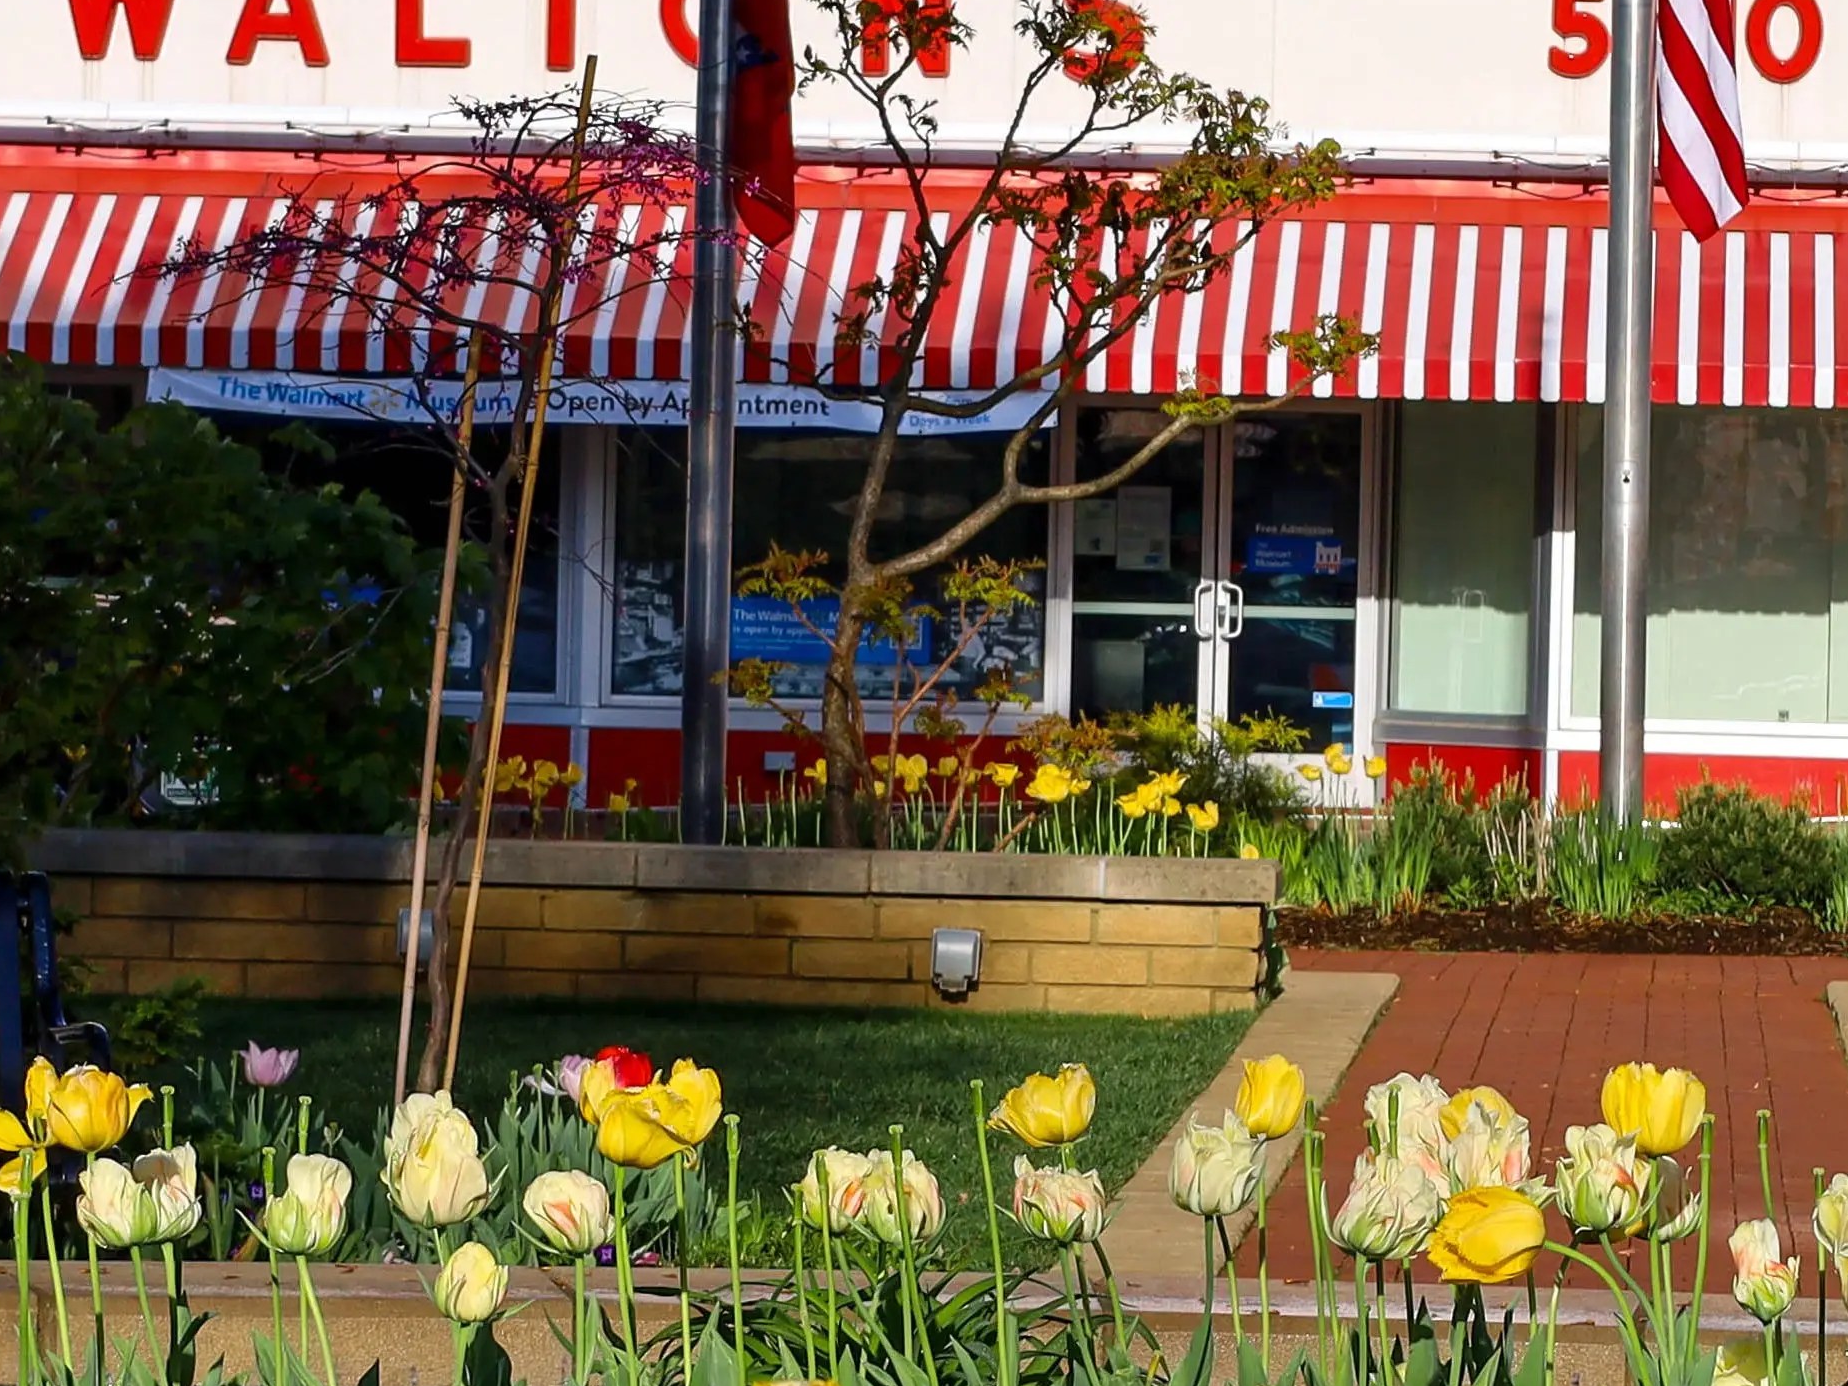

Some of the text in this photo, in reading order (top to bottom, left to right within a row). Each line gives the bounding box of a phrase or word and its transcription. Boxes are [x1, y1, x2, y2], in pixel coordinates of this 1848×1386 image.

[217, 376, 261, 401] The
[266, 382, 364, 408] Walmart
[406, 389, 511, 412] Musum
[548, 387, 614, 417] Open
[624, 389, 654, 418] by
[661, 389, 830, 420] Apntment
[733, 608, 756, 621] The
